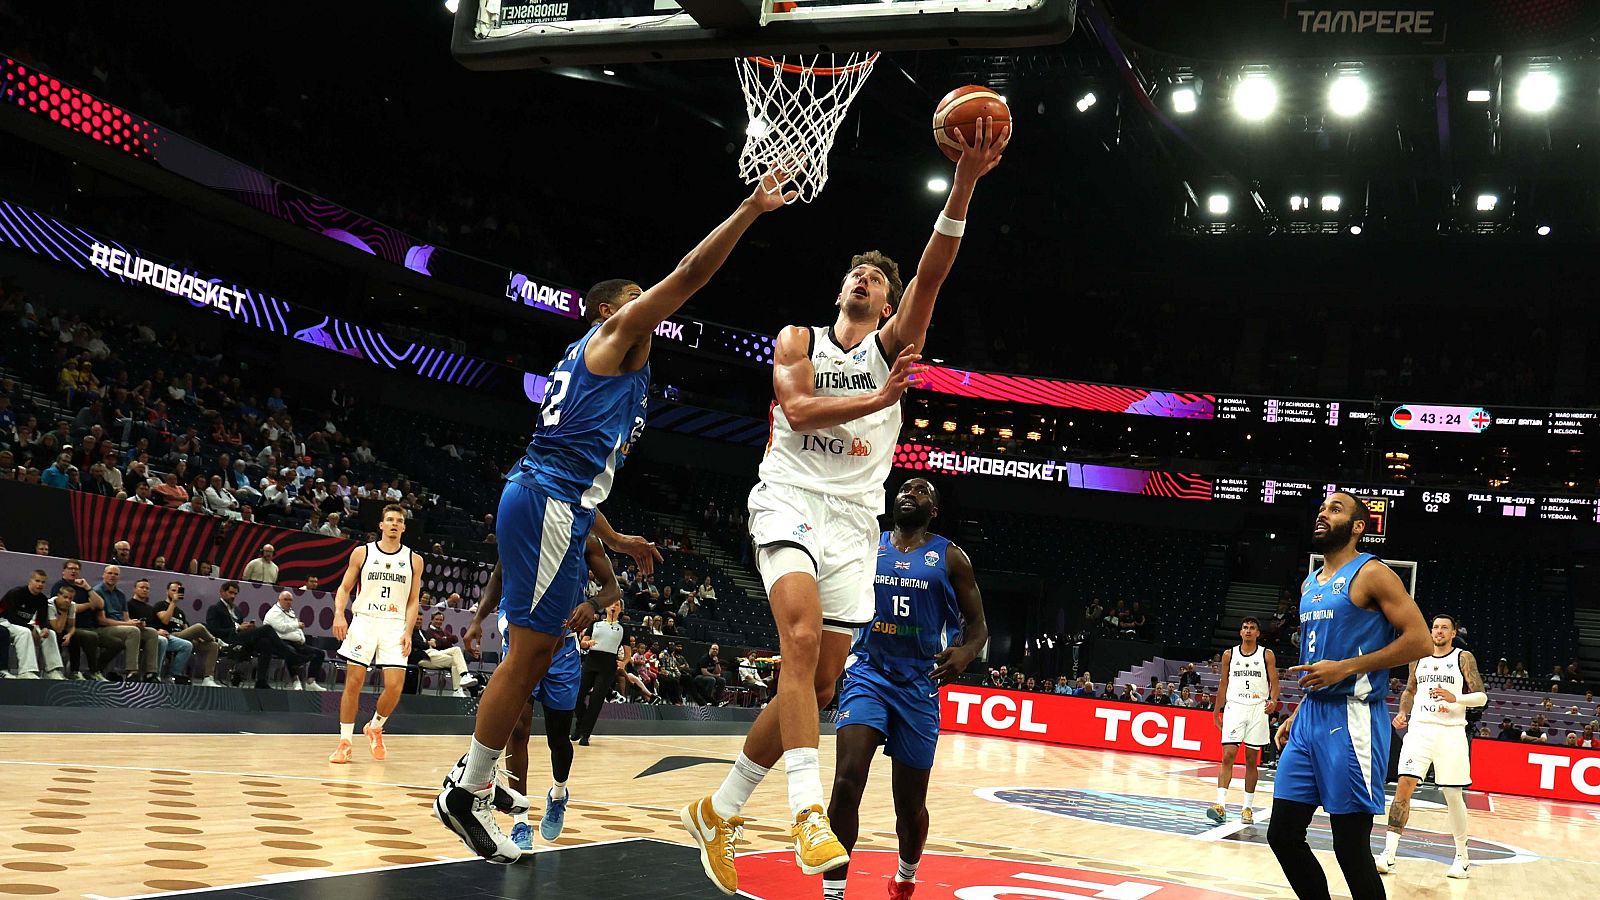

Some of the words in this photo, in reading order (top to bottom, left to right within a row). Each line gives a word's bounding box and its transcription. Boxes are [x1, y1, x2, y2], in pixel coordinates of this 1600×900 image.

[1298, 10, 1434, 33] TAMPERE
[89, 241, 246, 314] #EUROBASKET
[521, 280, 572, 312] MAKE
[653, 319, 685, 341] ARK
[814, 371, 878, 390] UTSCHLAND
[802, 434, 845, 455] ING
[928, 450, 1067, 482] #EUROBASKET
[1382, 488, 1405, 496] FOULS
[1422, 492, 1450, 504] 6:58
[1496, 496, 1536, 504] TIME-OUTS
[1425, 504, 1438, 512] Q2
[1477, 505, 1482, 514] 1
[368, 572, 406, 584] DEUTSCHLAND
[876, 574, 899, 586] GREAT
[900, 578, 929, 590] BRITAIN
[381, 586, 390, 598] 21
[368, 603, 386, 612] ING
[892, 595, 910, 618] 15
[1312, 609, 1334, 620] BRITAIN
[1308, 630, 1316, 653] 2
[1245, 680, 1250, 690] 5
[948, 692, 1048, 734] TCL
[1095, 708, 1201, 751] TCL
[1528, 752, 1600, 796] TC
